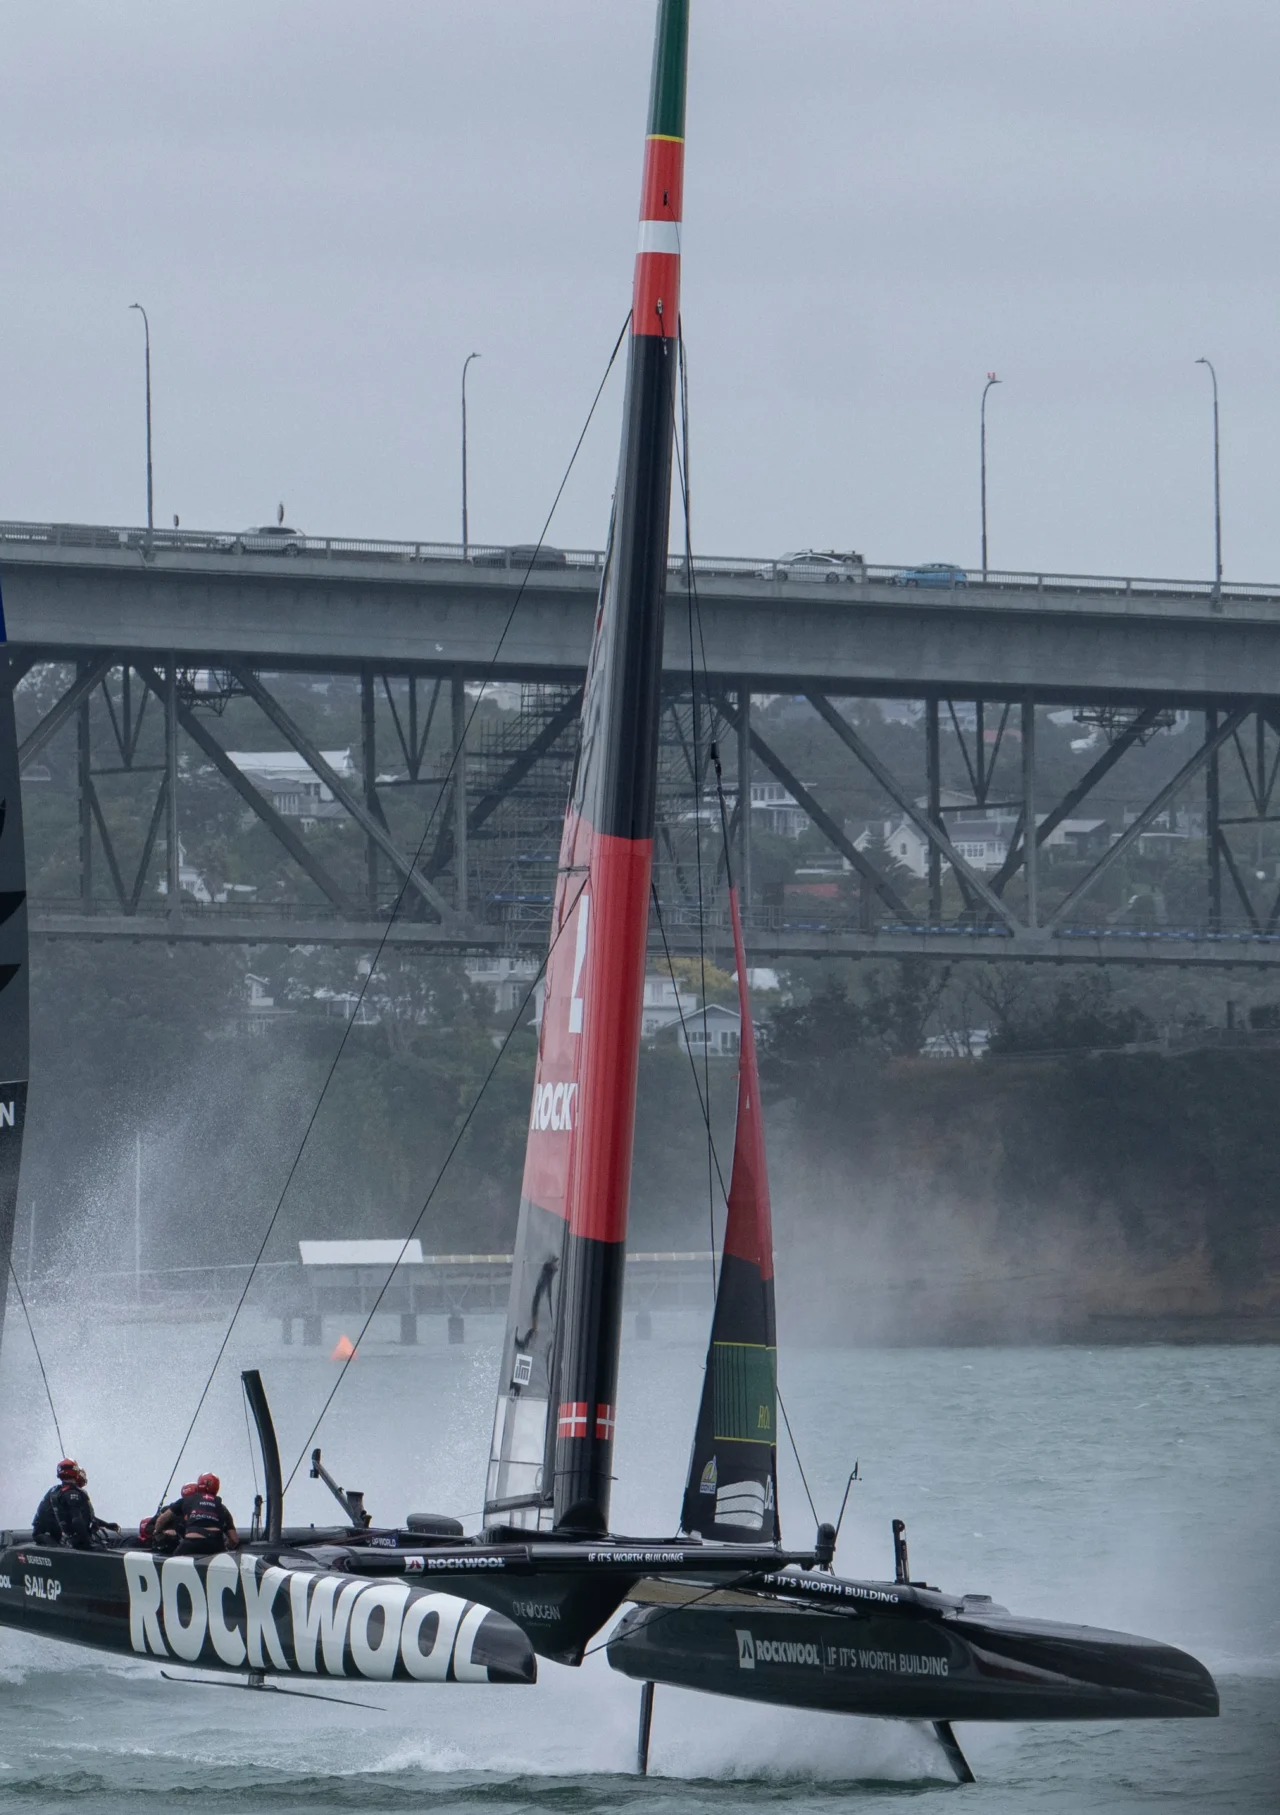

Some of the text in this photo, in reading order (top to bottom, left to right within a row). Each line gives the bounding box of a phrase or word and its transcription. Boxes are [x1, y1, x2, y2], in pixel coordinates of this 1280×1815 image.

[427, 1557, 505, 1569] ROCKWOOL
[588, 1552, 684, 1562] IF IT'S WORTH BUILDING
[764, 1574, 899, 1603] IF IT'S WORTH BUILDING
[124, 1551, 491, 1682] ROCKWOOL
[756, 1640, 949, 1676] ROCKWOOL IF IT'S WORTH BUILDING
